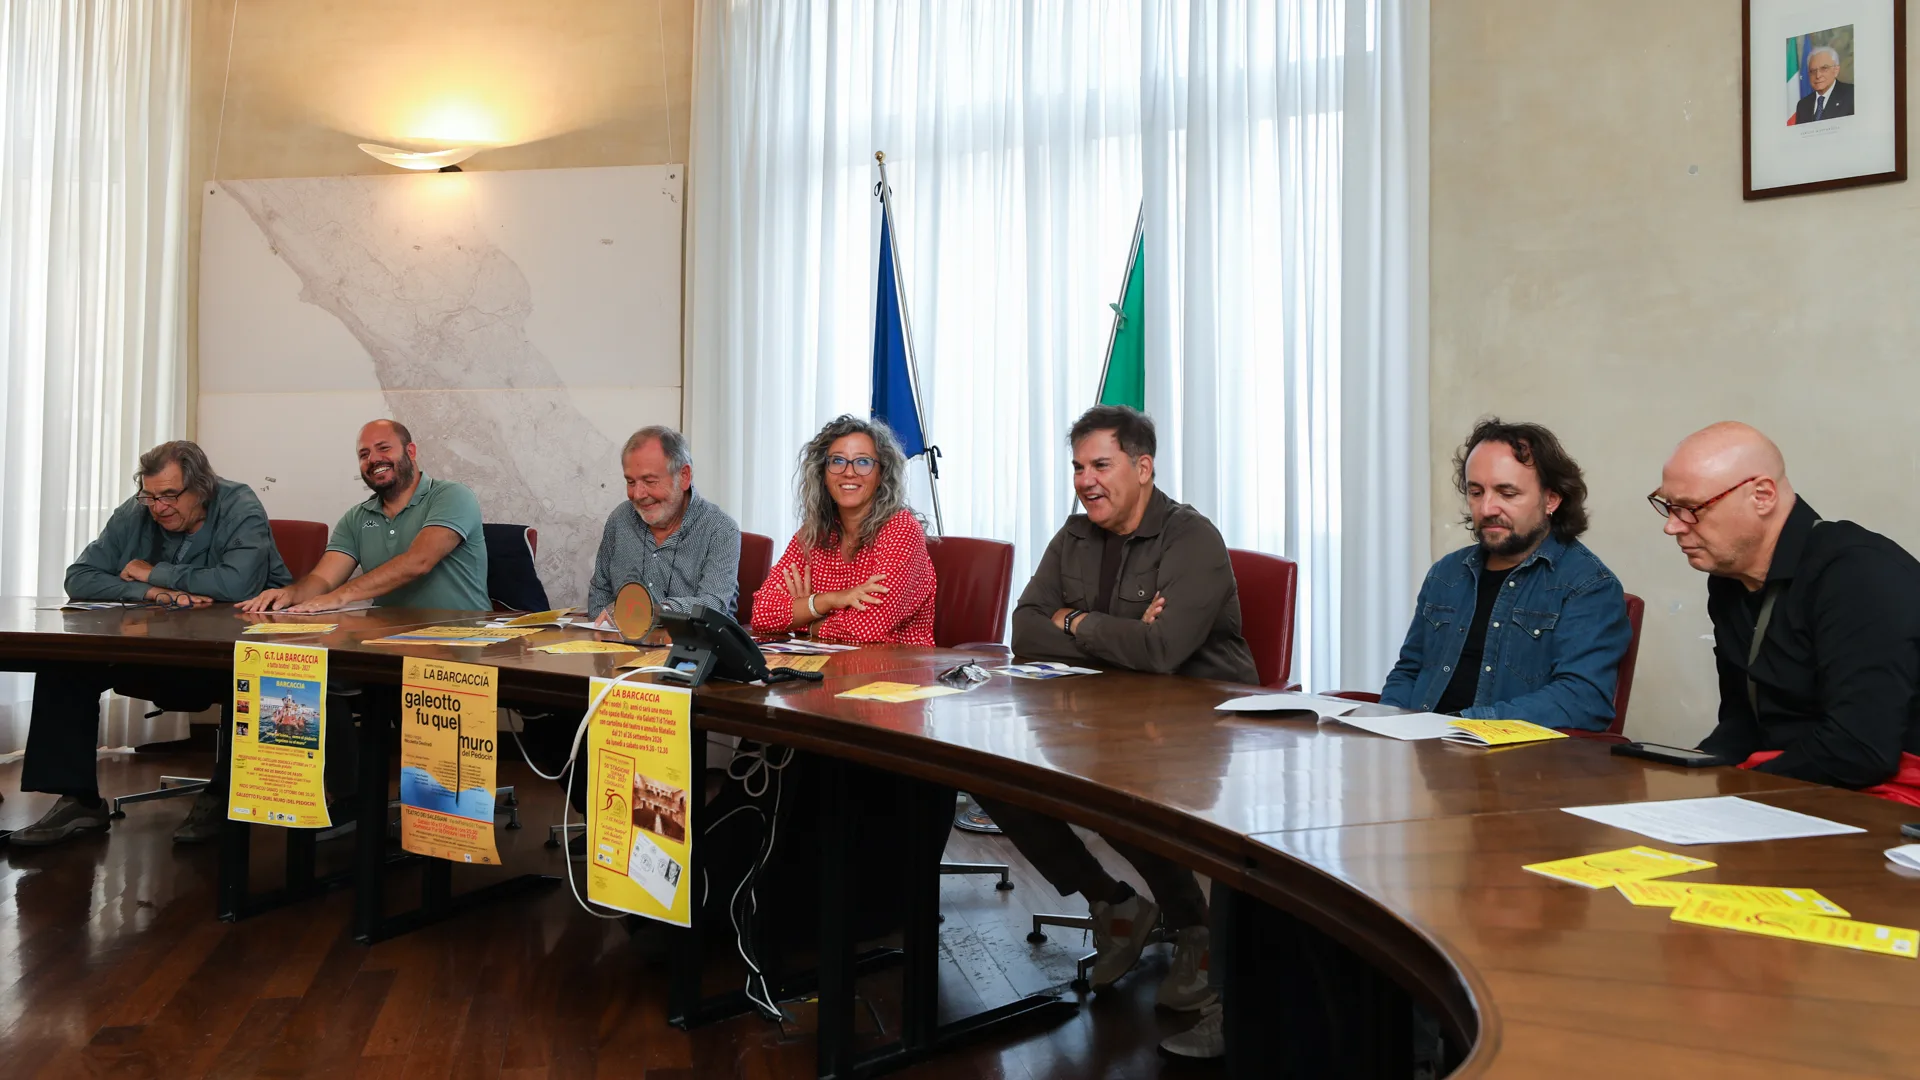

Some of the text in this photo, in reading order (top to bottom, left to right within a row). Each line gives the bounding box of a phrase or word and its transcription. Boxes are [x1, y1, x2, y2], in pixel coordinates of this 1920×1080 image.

[264, 651, 319, 664] G.T. LA BARCACCIA
[424, 668, 435, 680] LA
[437, 670, 489, 687] BARCACCIA
[276, 681, 305, 689] BARCACCIA
[405, 690, 460, 712] galeotto
[612, 689, 660, 703] LA BARCACCIA
[416, 708, 429, 725] fu
[663, 717, 676, 726] Trieste
[628, 722, 640, 730] teatro
[644, 724, 658, 733] annullo
[659, 726, 676, 735] filatelico
[460, 735, 493, 753] muro
[633, 733, 652, 742] settembre
[646, 744, 654, 752] 9.30
[470, 751, 493, 760] Pedocin
[601, 788, 628, 817] 50
[406, 808, 419, 817] TEATRO
[426, 813, 447, 822] SALESIANI
